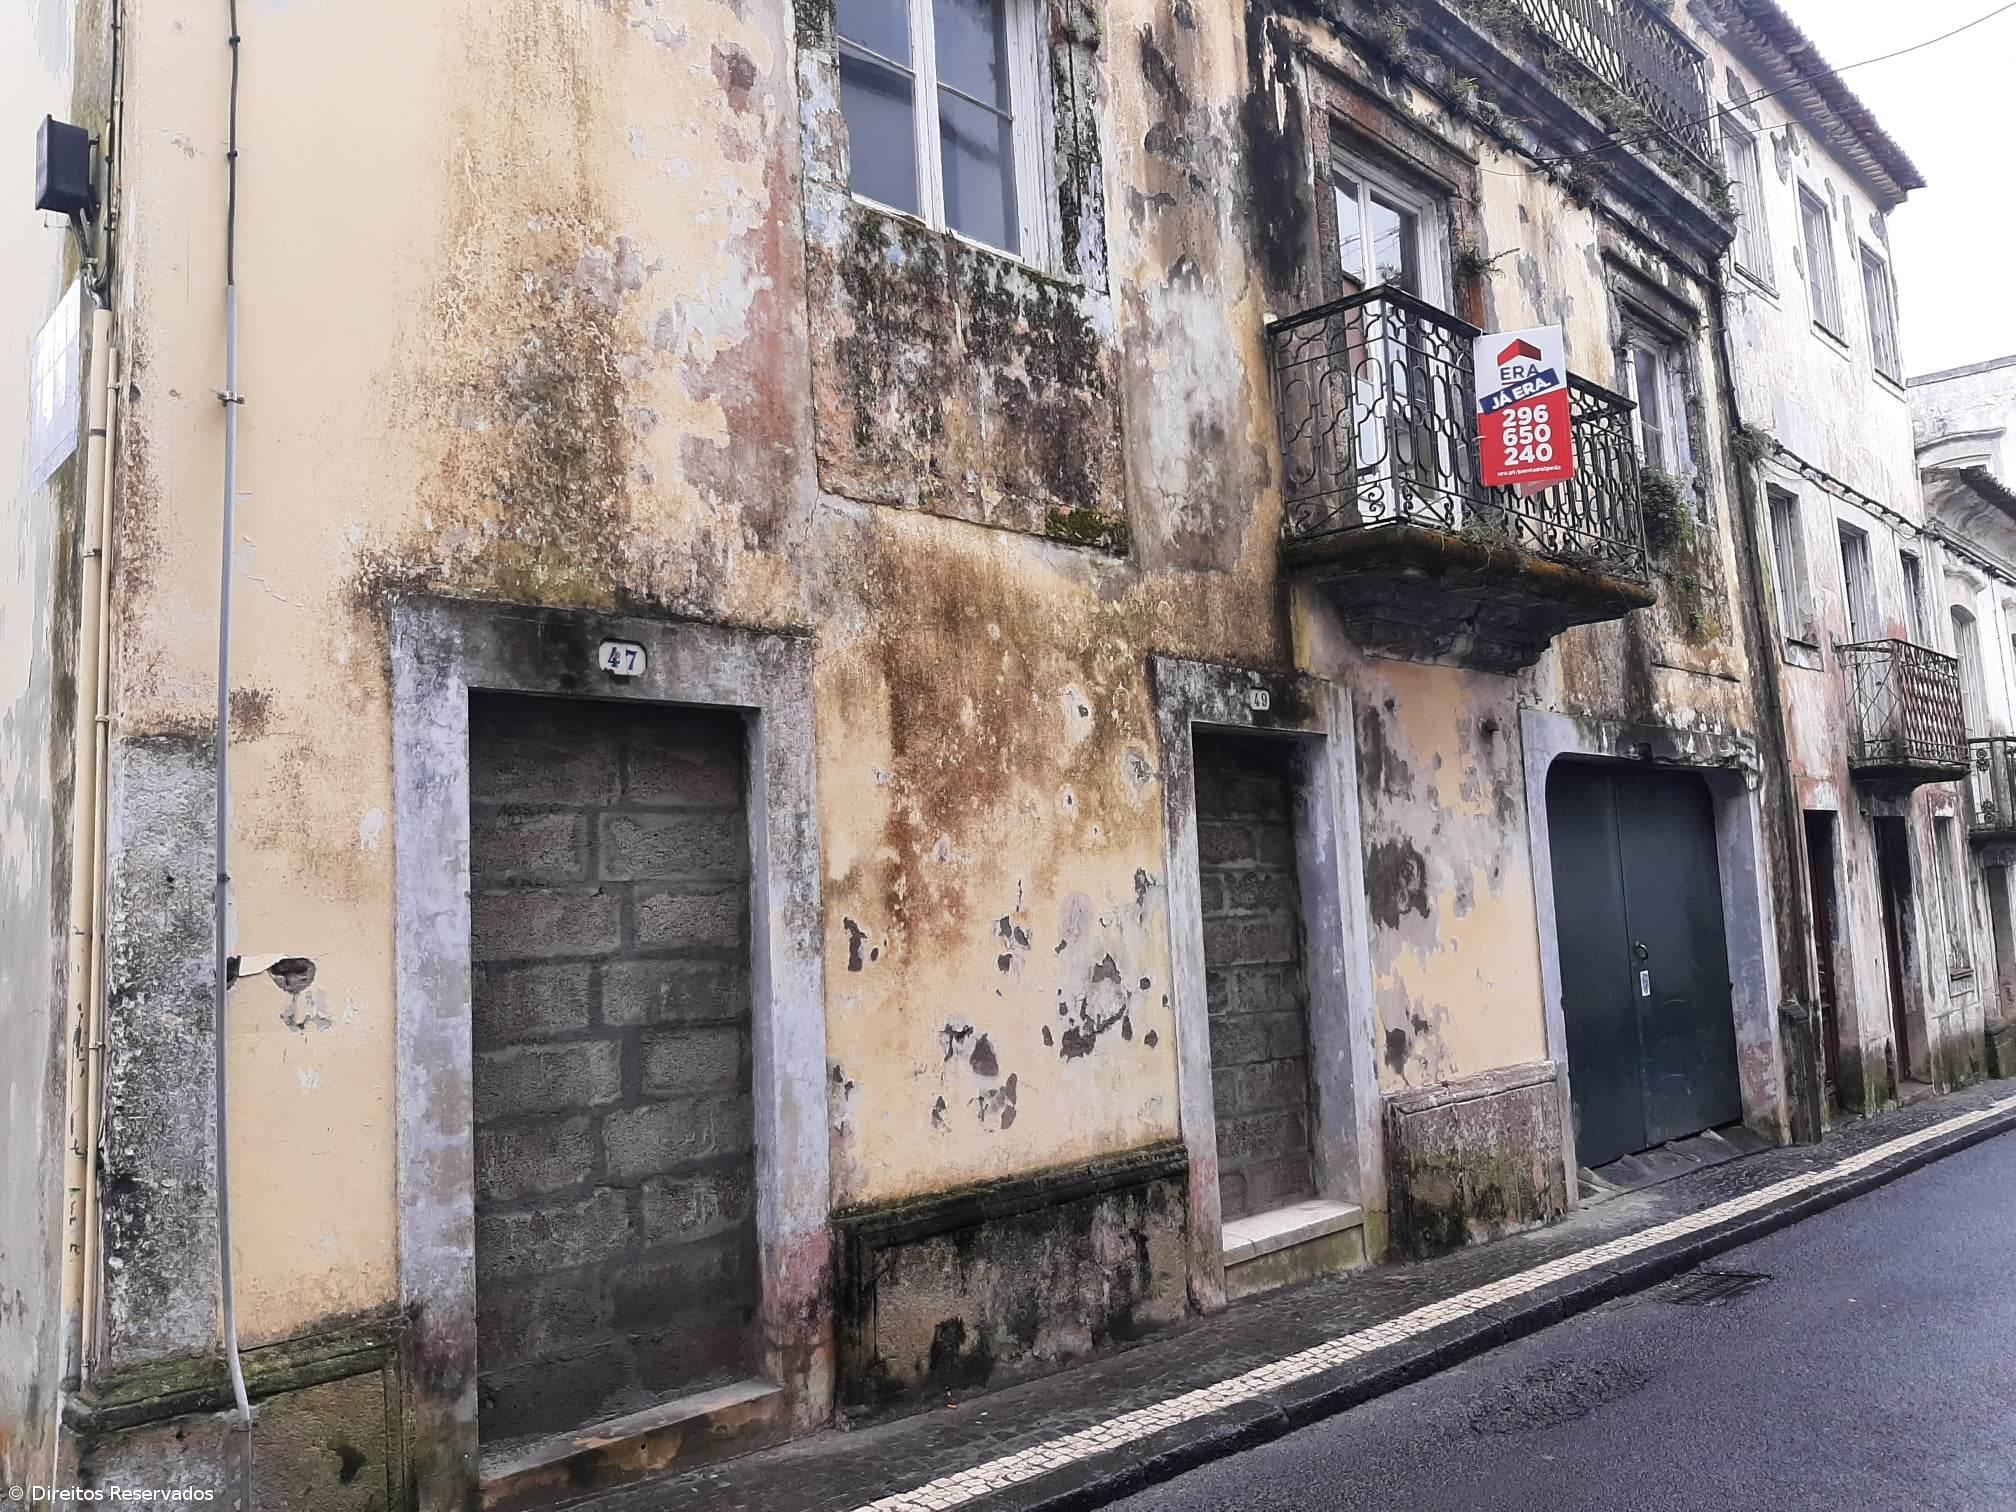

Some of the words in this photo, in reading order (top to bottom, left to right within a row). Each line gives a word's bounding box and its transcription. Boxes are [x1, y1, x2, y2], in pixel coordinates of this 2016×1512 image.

[1500, 363, 1539, 381] ERA
[1492, 391, 1512, 410] JÁ
[1502, 404, 1550, 428] 296
[1503, 423, 1551, 447] 650
[1504, 443, 1553, 466] 240
[607, 646, 638, 671] 47
[1254, 692, 1268, 707] 49
